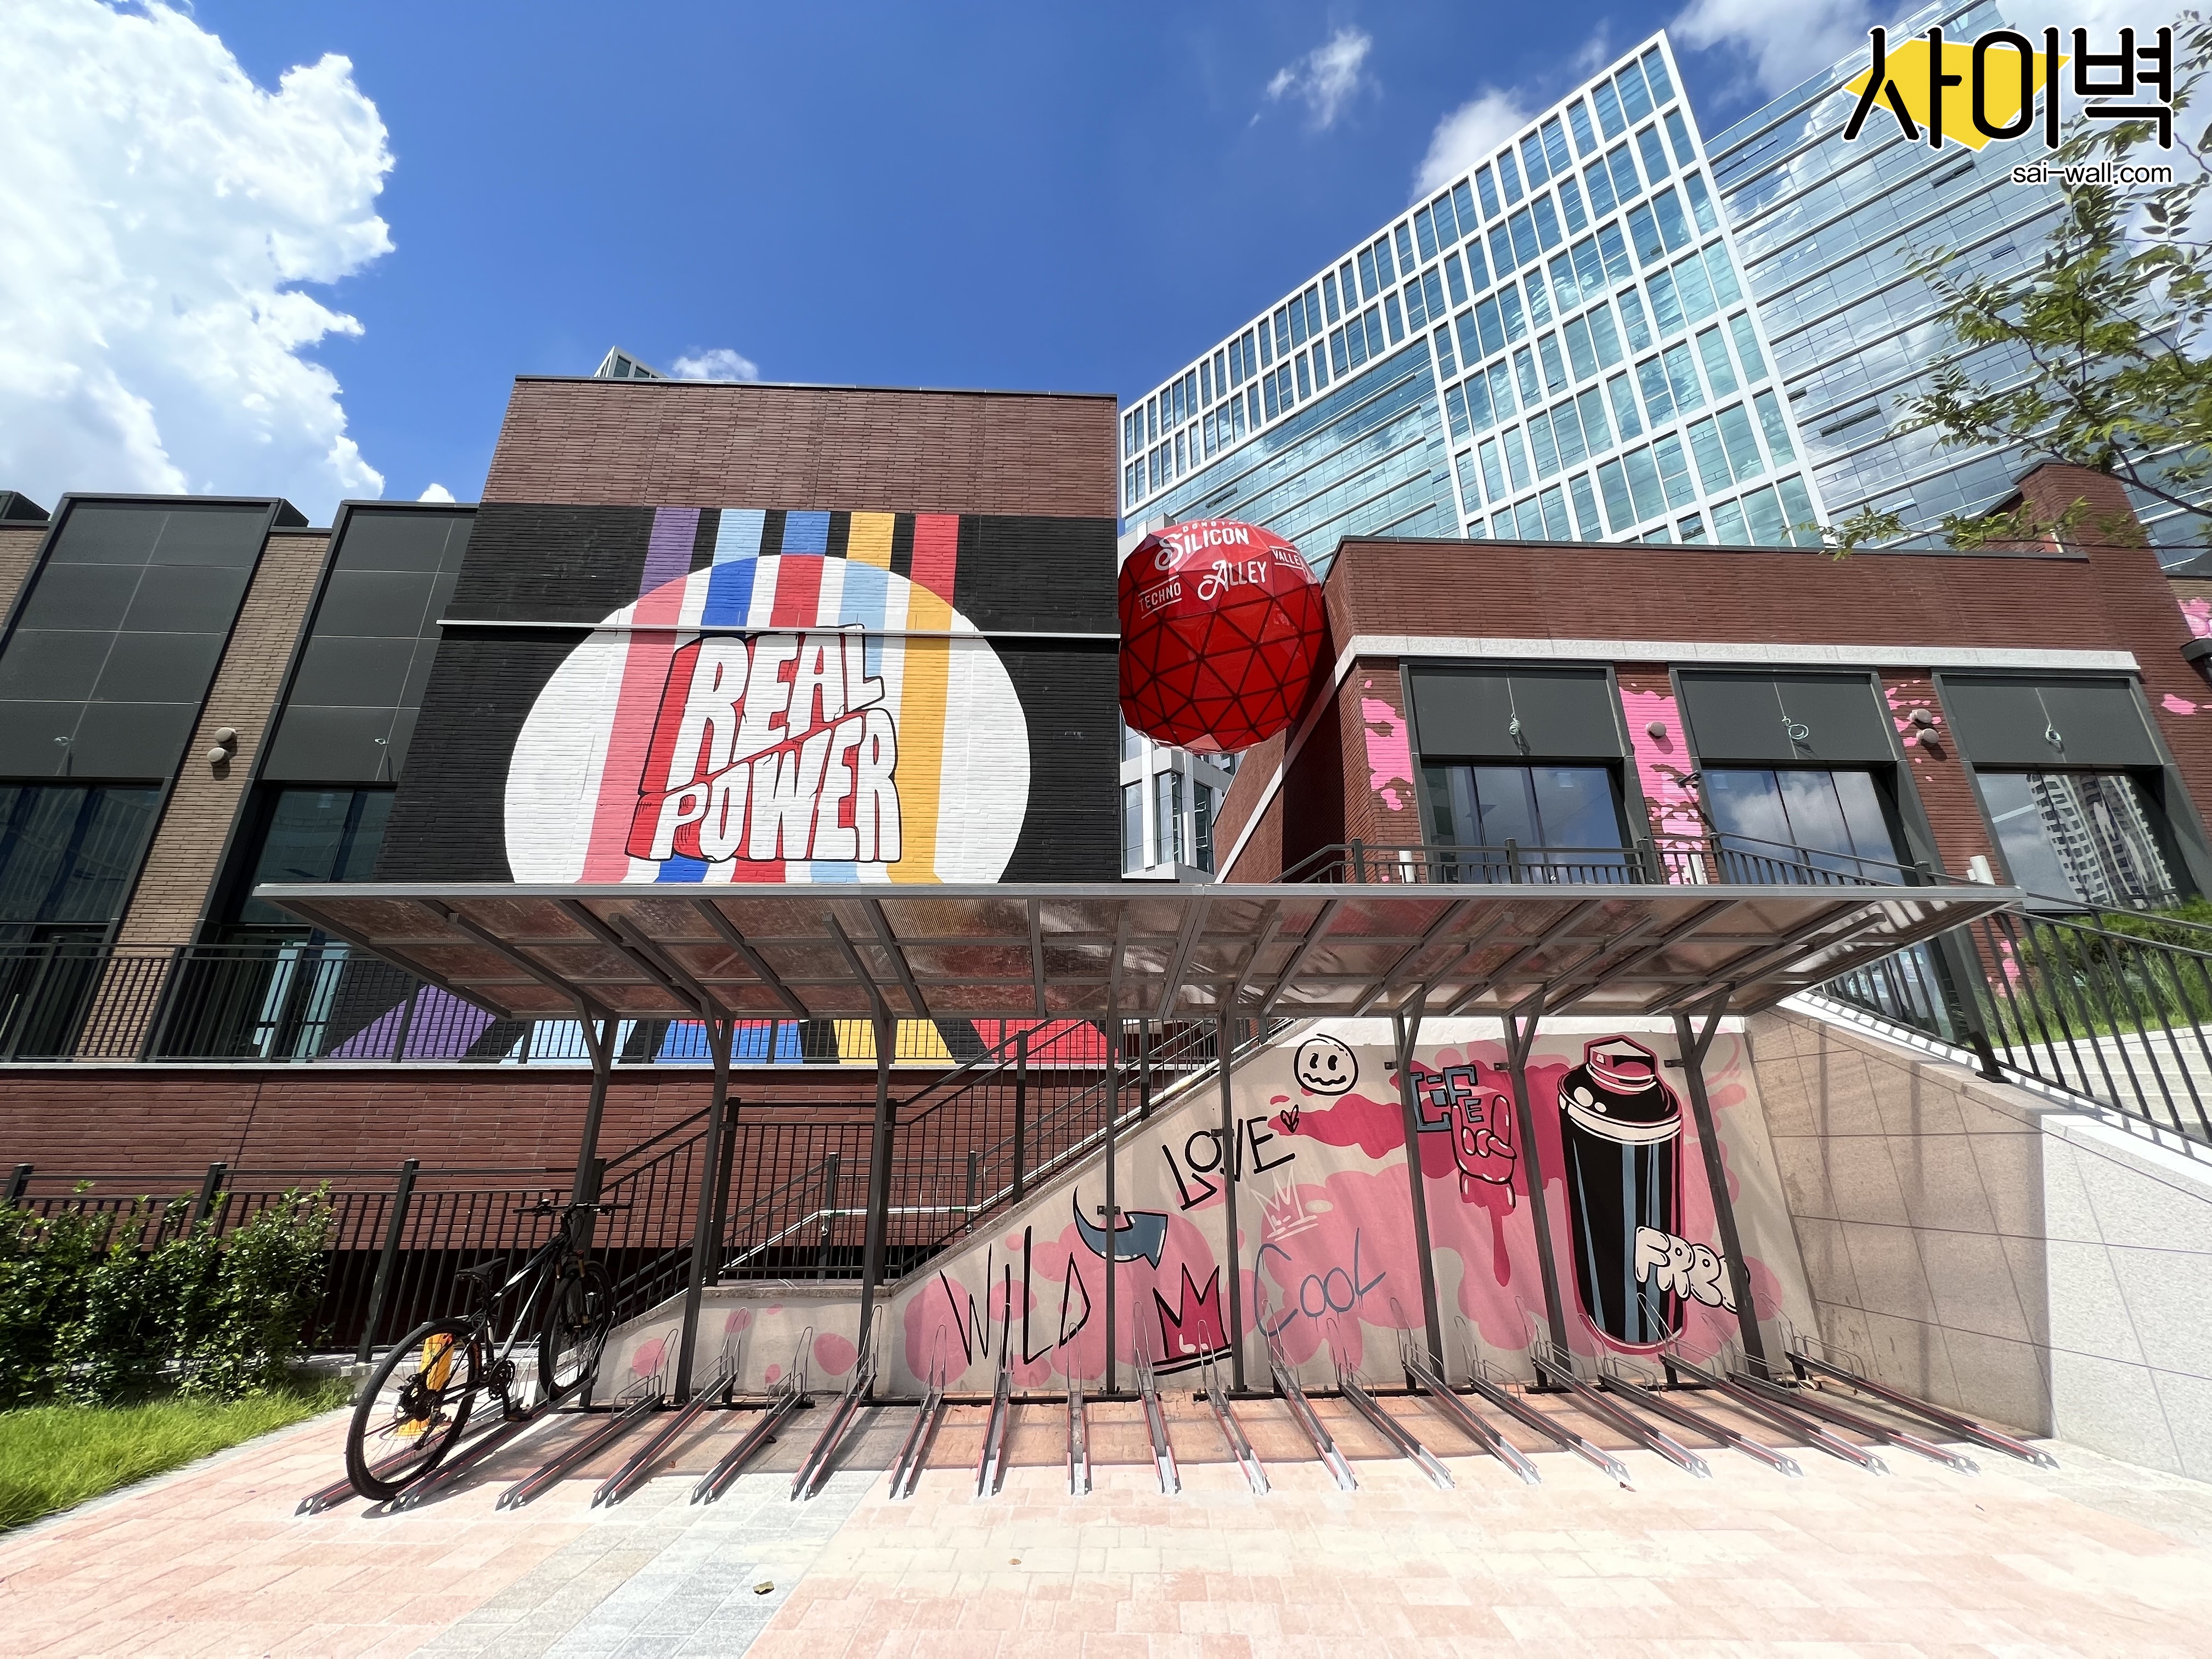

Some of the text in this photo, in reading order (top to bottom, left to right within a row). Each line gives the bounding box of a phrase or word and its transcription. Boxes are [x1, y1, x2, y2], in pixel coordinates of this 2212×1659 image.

[1154, 527, 1250, 571] SILICON
[1198, 560, 1267, 601] ALLEY
[1272, 549, 1304, 566] VALLE
[1138, 582, 1181, 611] TECHNO
[661, 623, 885, 793] REAL
[646, 708, 902, 862] POWER
[1163, 1115, 1295, 1211] LOVE
[940, 1225, 1091, 1366] WILD
